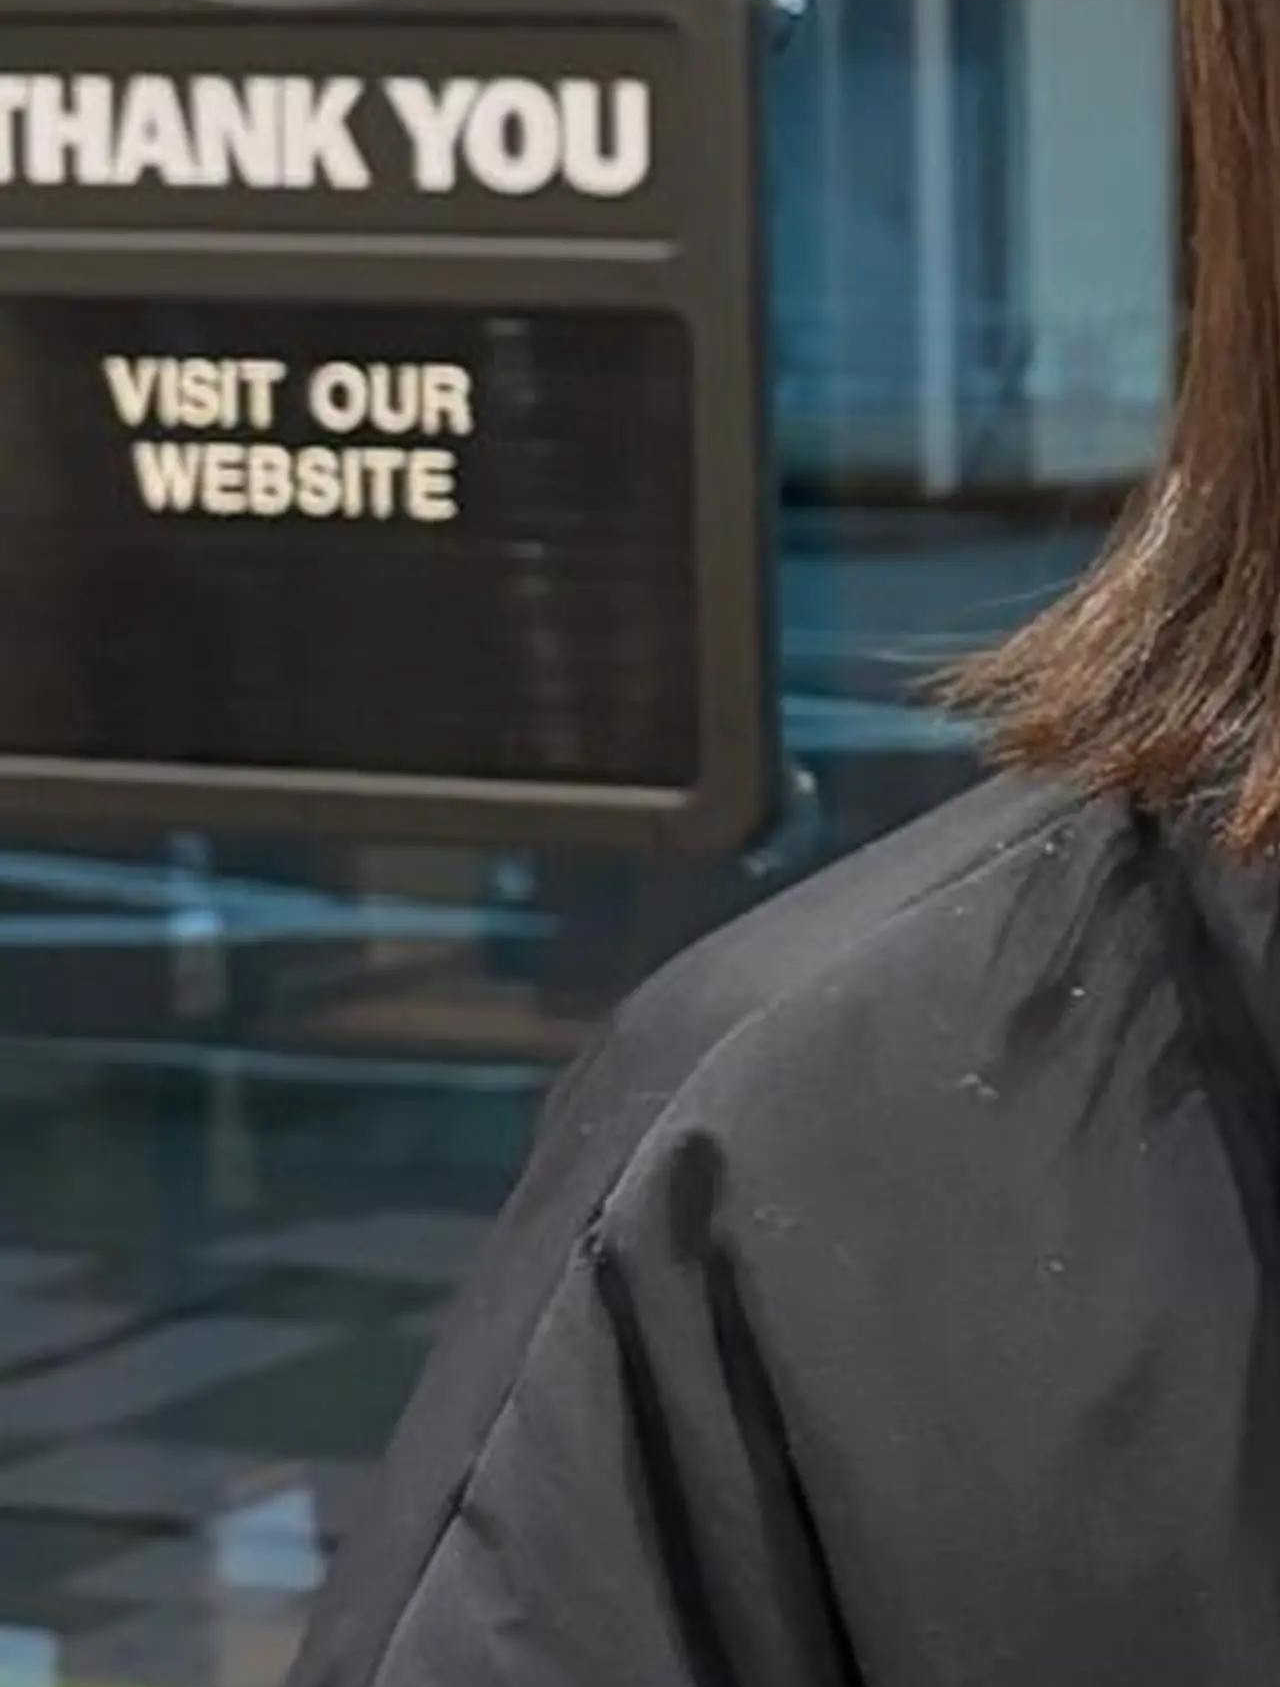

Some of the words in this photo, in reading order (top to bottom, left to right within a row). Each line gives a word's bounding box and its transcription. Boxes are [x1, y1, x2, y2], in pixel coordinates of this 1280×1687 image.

[384, 75, 651, 197] YOU
[103, 356, 286, 430] VISIT
[308, 360, 473, 436] OUR
[132, 440, 458, 522] WEBSITE
